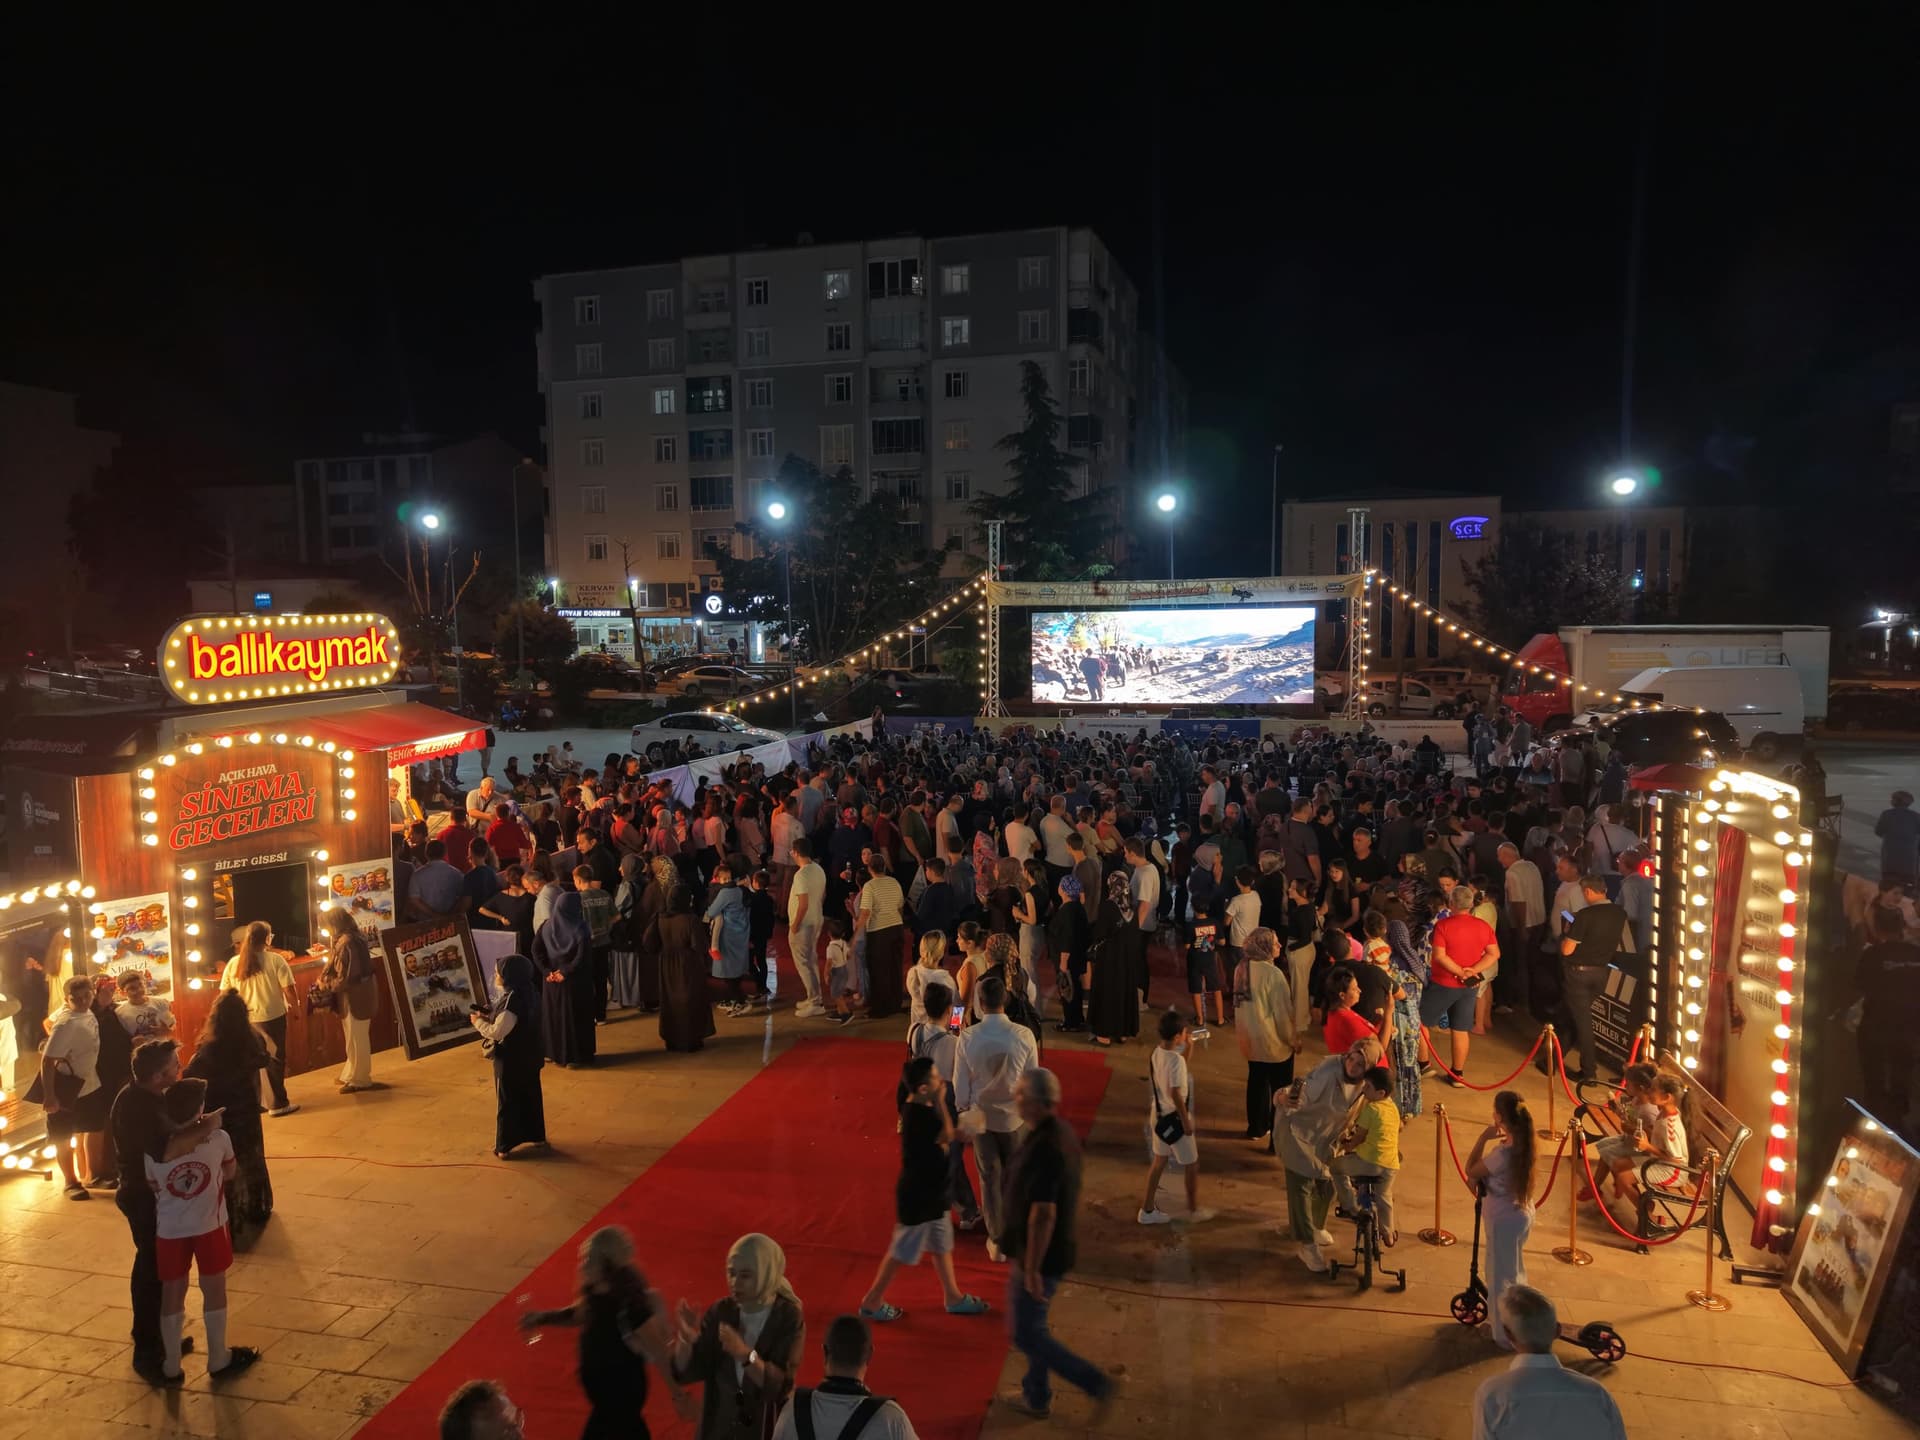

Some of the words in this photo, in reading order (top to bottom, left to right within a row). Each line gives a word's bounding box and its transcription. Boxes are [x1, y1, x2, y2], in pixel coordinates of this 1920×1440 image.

[1456, 524, 1482, 535] SGK
[579, 584, 615, 592] KERVAN
[218, 768, 246, 785] AÇIK
[247, 763, 278, 778] HAVA
[178, 770, 304, 821] SİNEMA
[167, 786, 317, 851] GECELERİ
[214, 857, 249, 871] BİLET
